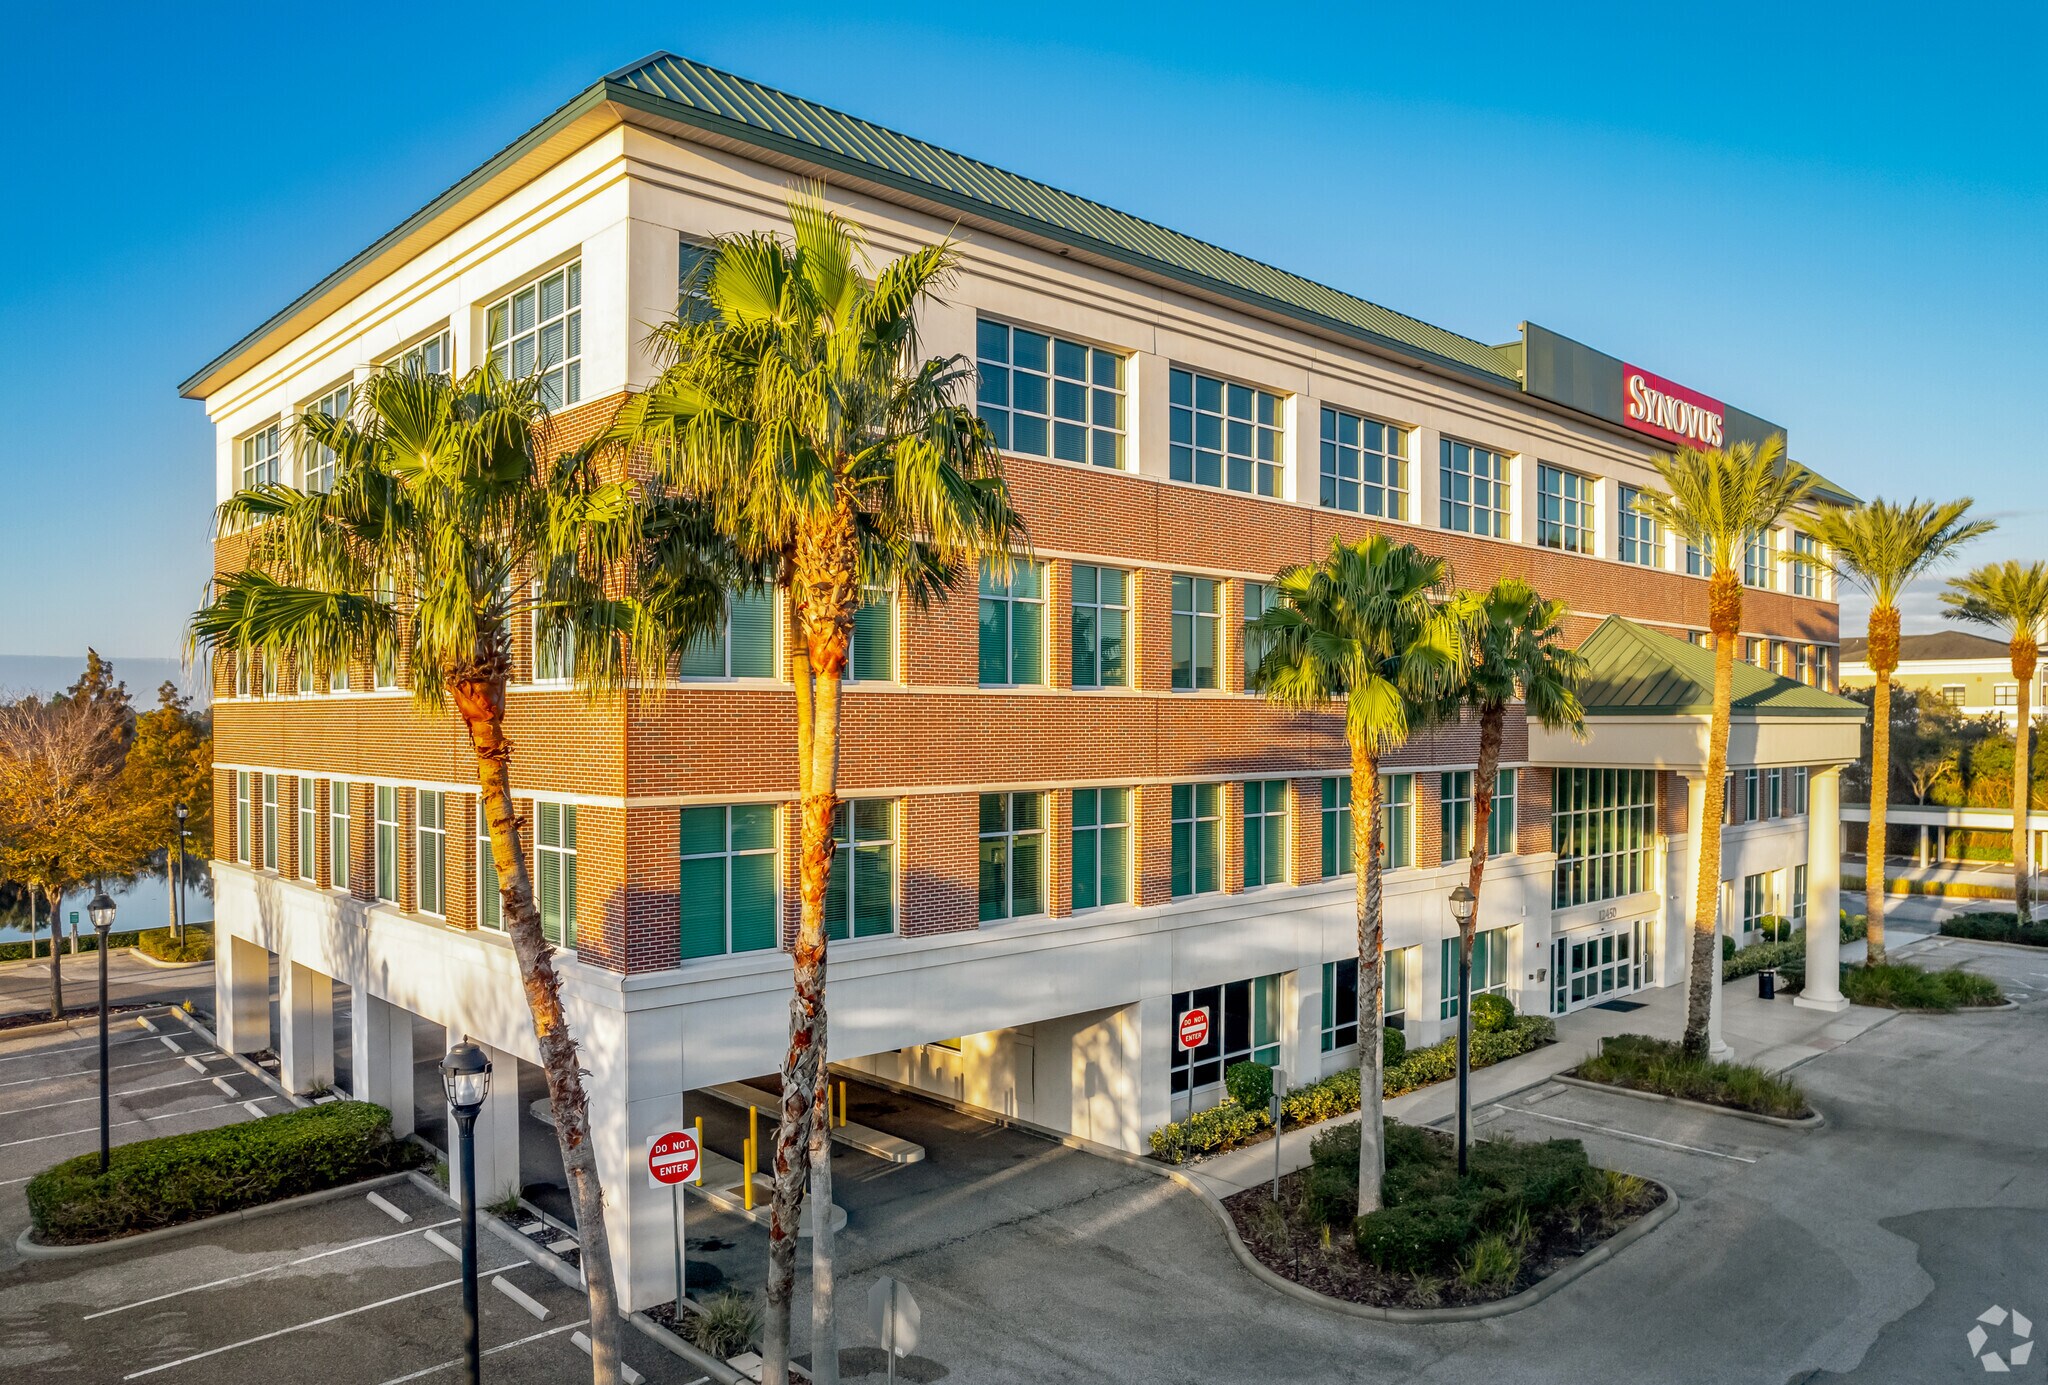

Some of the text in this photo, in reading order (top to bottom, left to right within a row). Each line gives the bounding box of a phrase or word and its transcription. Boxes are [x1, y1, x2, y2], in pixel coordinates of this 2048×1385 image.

[1629, 374, 1723, 448] SYNOVUS
[1184, 1015, 1205, 1026] DO NOT
[1185, 1032, 1202, 1042] ENTER
[655, 1139, 690, 1154] DO NOT
[660, 1163, 689, 1176] ENTER
